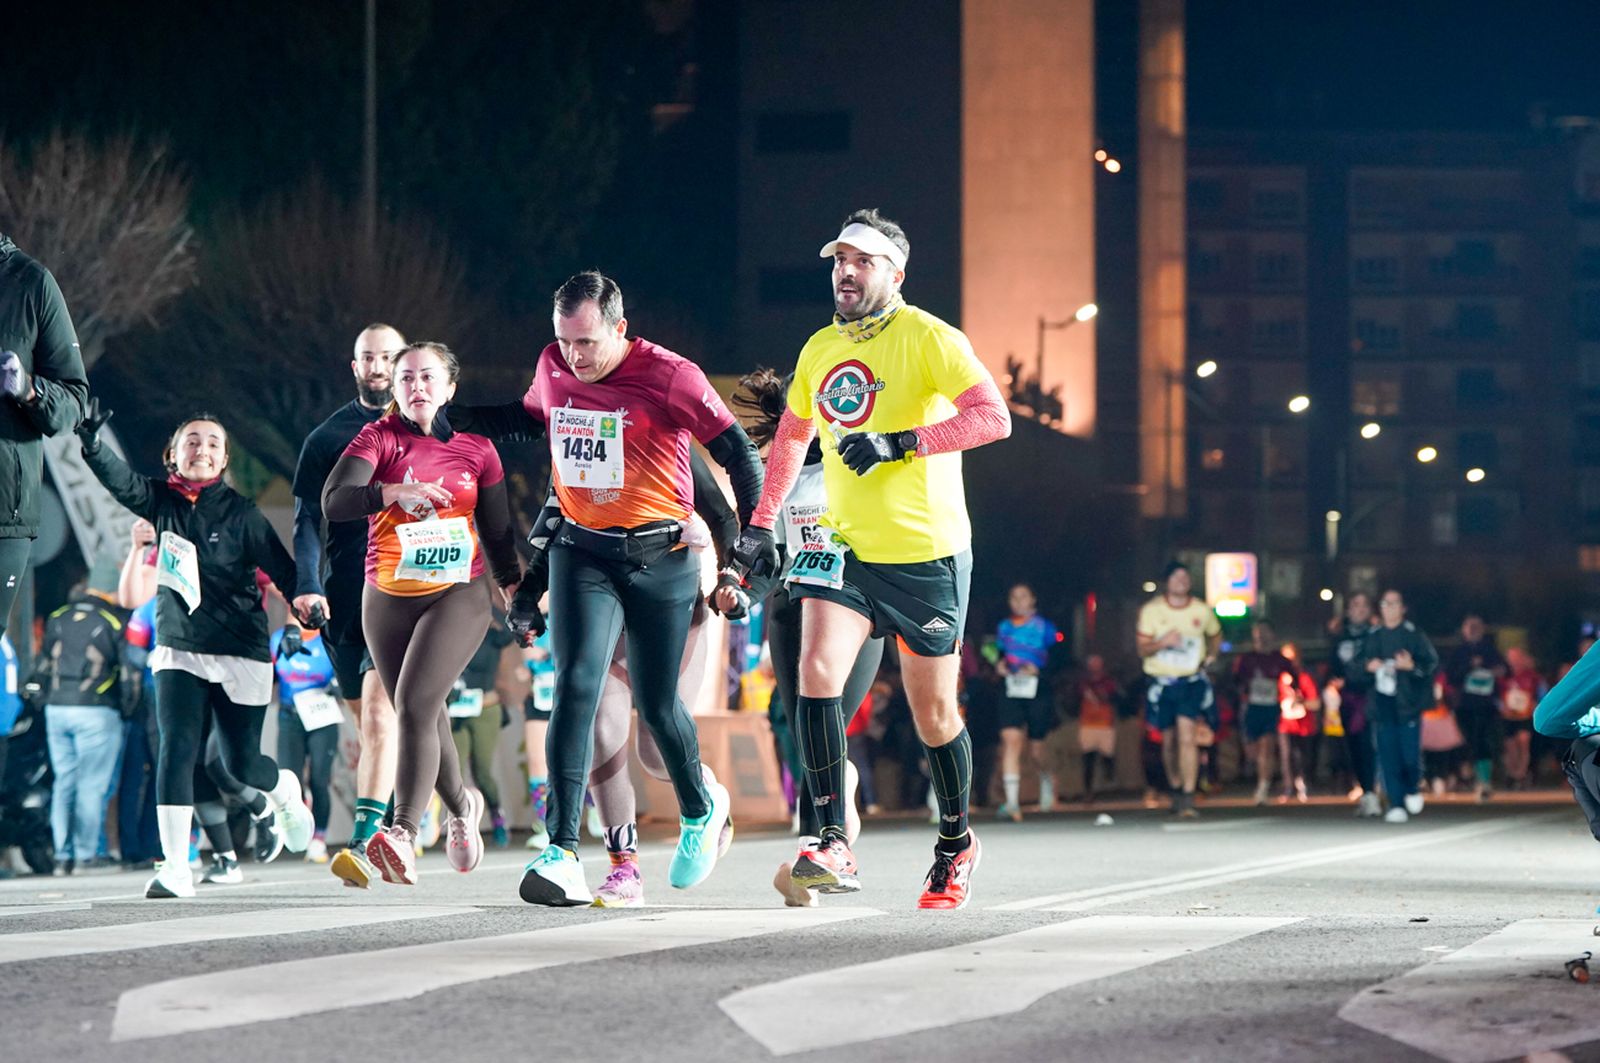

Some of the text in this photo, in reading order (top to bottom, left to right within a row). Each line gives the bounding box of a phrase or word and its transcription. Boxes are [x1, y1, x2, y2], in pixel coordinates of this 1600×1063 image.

[848, 377, 885, 397] Antonio
[566, 417, 587, 427] NOCHE
[557, 425, 571, 435] SAN
[562, 437, 607, 462] 1434
[798, 506, 820, 516] NOCHE
[792, 516, 805, 525] SAN
[414, 547, 461, 565] 6205
